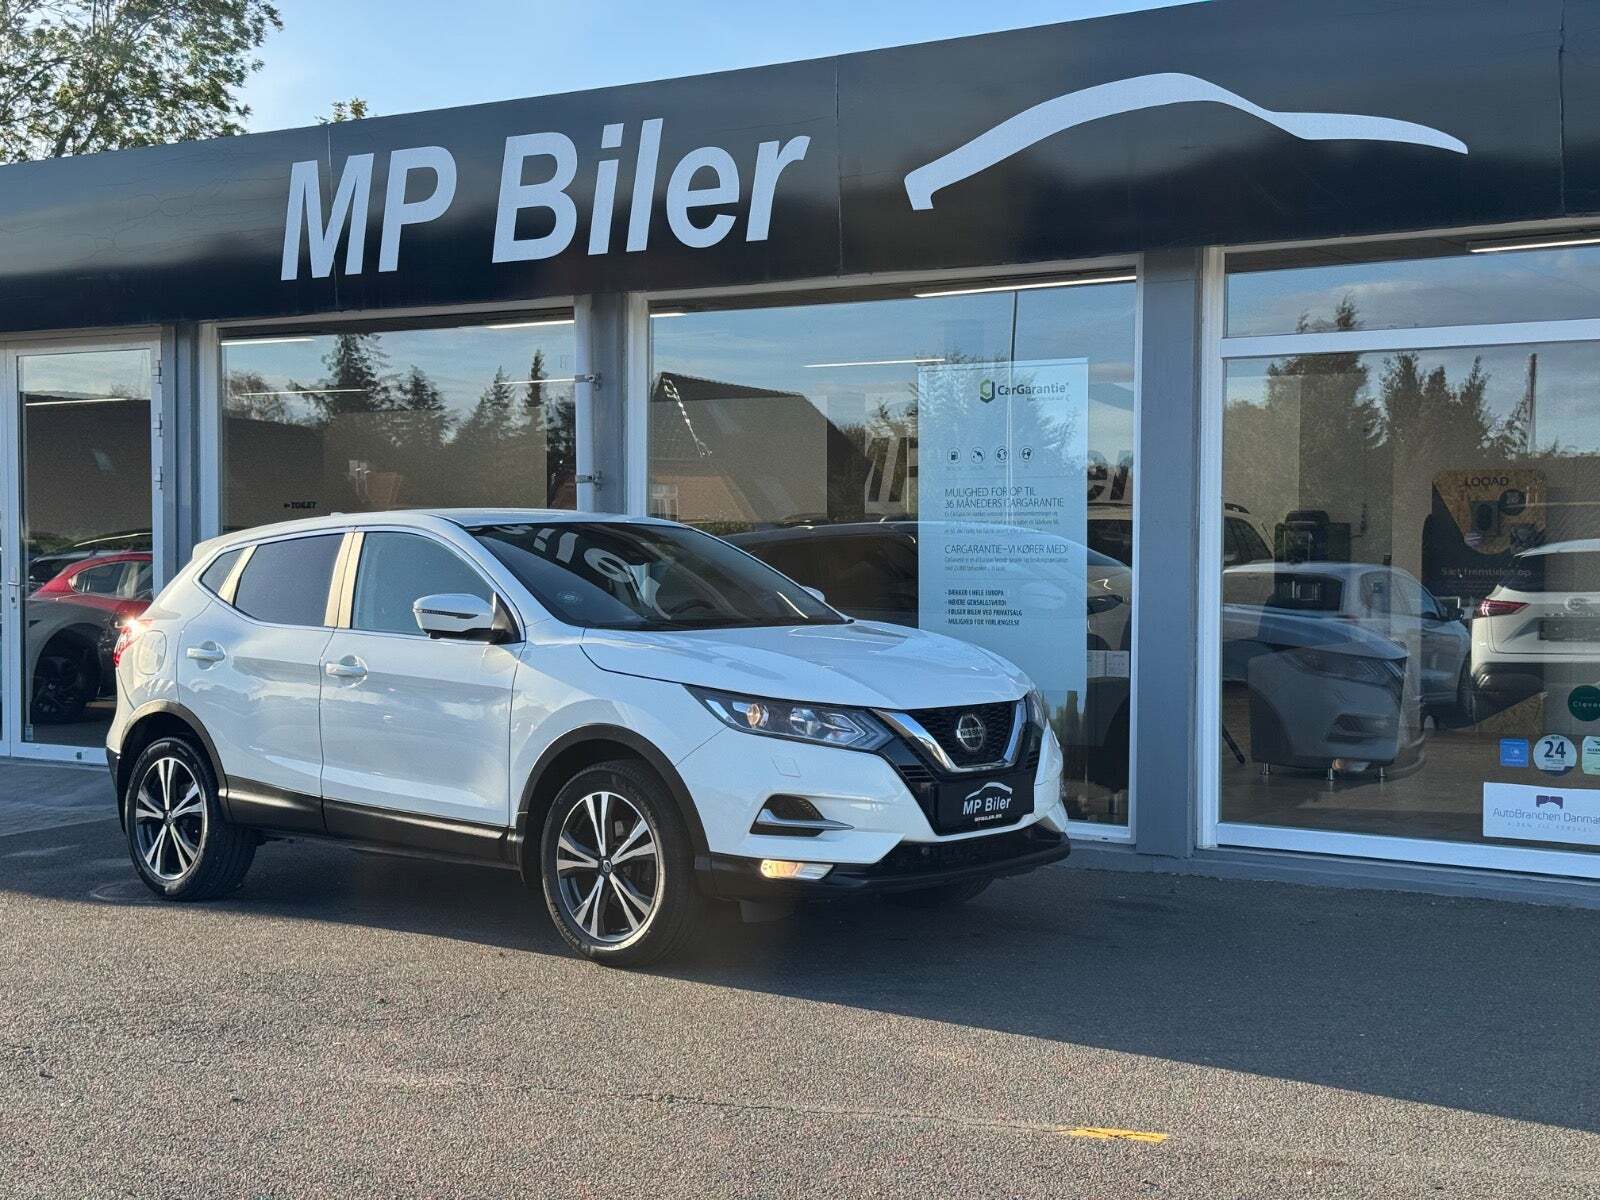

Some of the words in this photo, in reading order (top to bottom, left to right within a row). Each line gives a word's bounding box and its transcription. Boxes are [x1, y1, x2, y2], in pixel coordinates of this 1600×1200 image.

[280, 145, 457, 281] MP
[491, 117, 811, 264] Biler
[997, 382, 1067, 396] CarGarantie
[944, 487, 988, 497] MULIGHED
[1025, 486, 1036, 496] TIL
[944, 499, 955, 509] 36
[956, 498, 1001, 509] MÅNEDERS
[1543, 740, 1566, 759] 24
[963, 799, 982, 815] MP
[984, 796, 1012, 812] Biler
[1492, 807, 1561, 822] AutoBranchen
